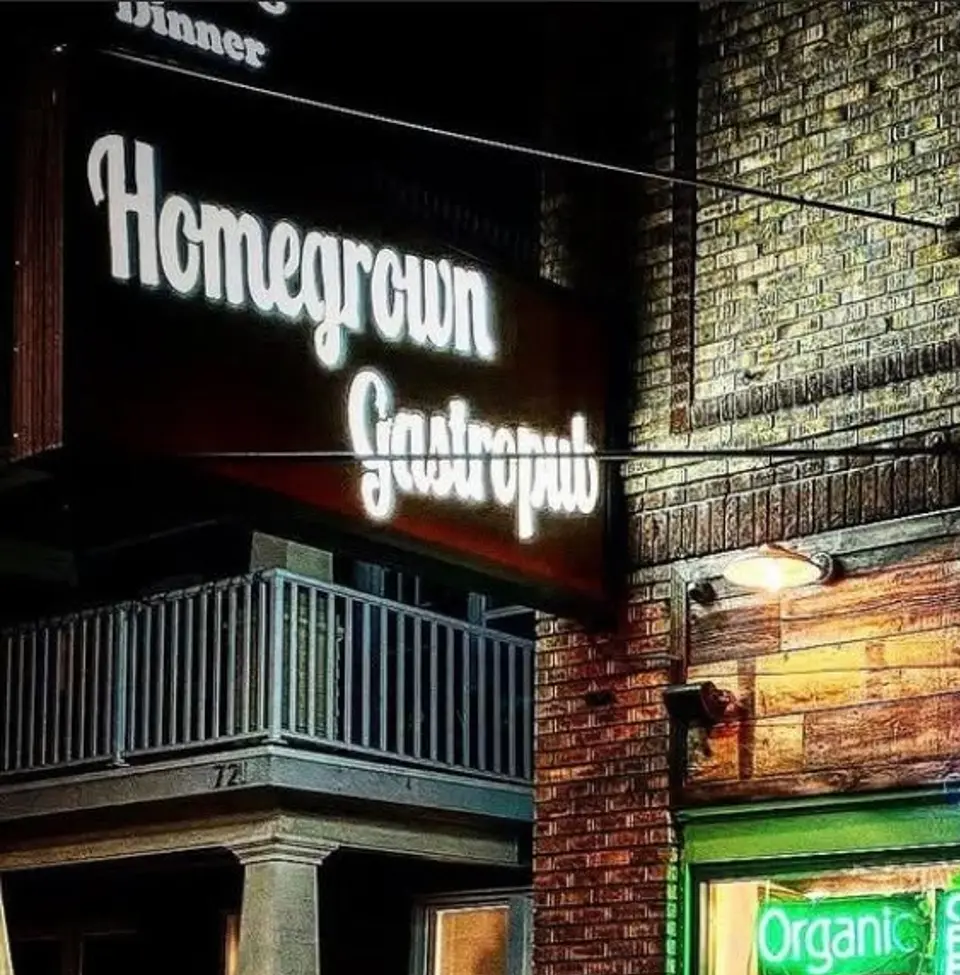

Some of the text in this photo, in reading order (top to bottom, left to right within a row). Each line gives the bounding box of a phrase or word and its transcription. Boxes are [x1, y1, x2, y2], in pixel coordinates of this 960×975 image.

[115, 2, 266, 68] Dinner
[87, 132, 497, 370] Homegrown
[346, 367, 601, 541] Gastropub
[759, 907, 918, 975] Organic
